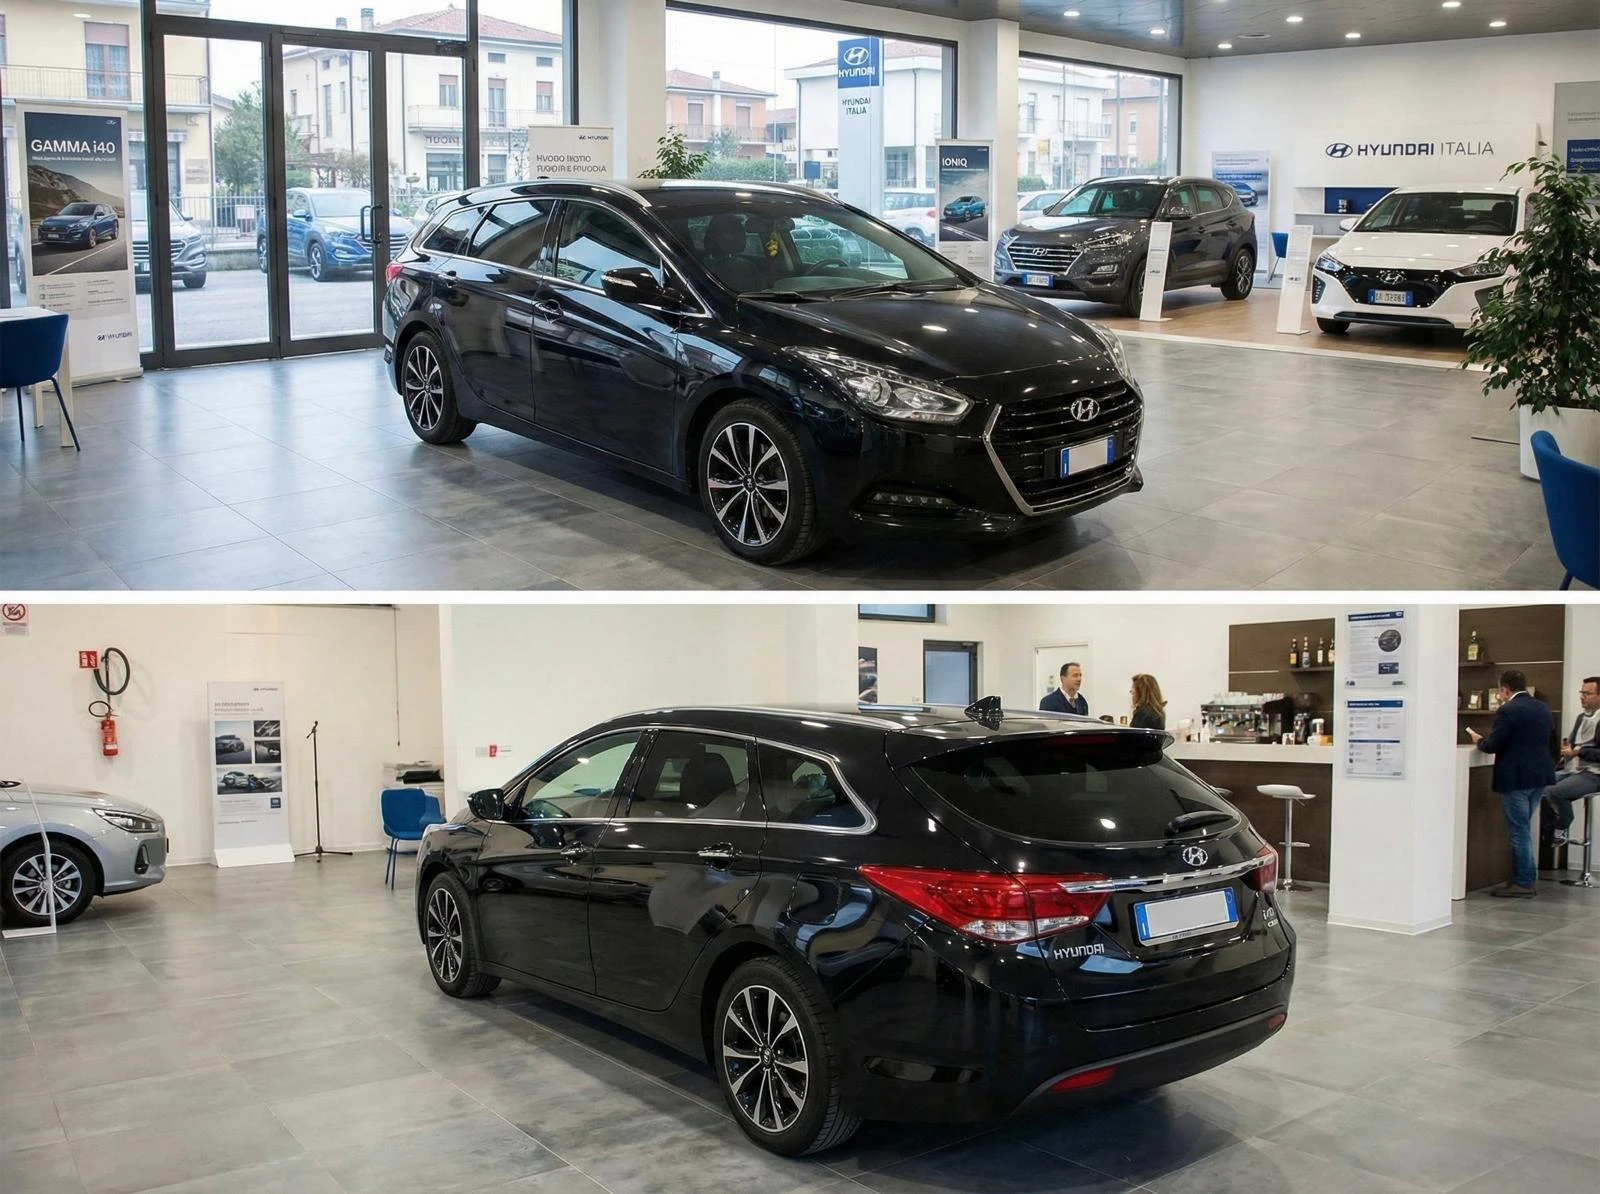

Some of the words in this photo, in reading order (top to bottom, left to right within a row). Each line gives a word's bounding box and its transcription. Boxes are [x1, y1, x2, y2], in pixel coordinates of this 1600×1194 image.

[838, 66, 876, 78] HYUNDAI
[31, 139, 91, 153] GAMMA
[93, 140, 116, 154] i40
[1357, 143, 1434, 156] HYUNDAI
[1440, 141, 1494, 155] ITALIA
[942, 158, 968, 168] IONIQ
[1053, 943, 1105, 960] HYUNDAI
